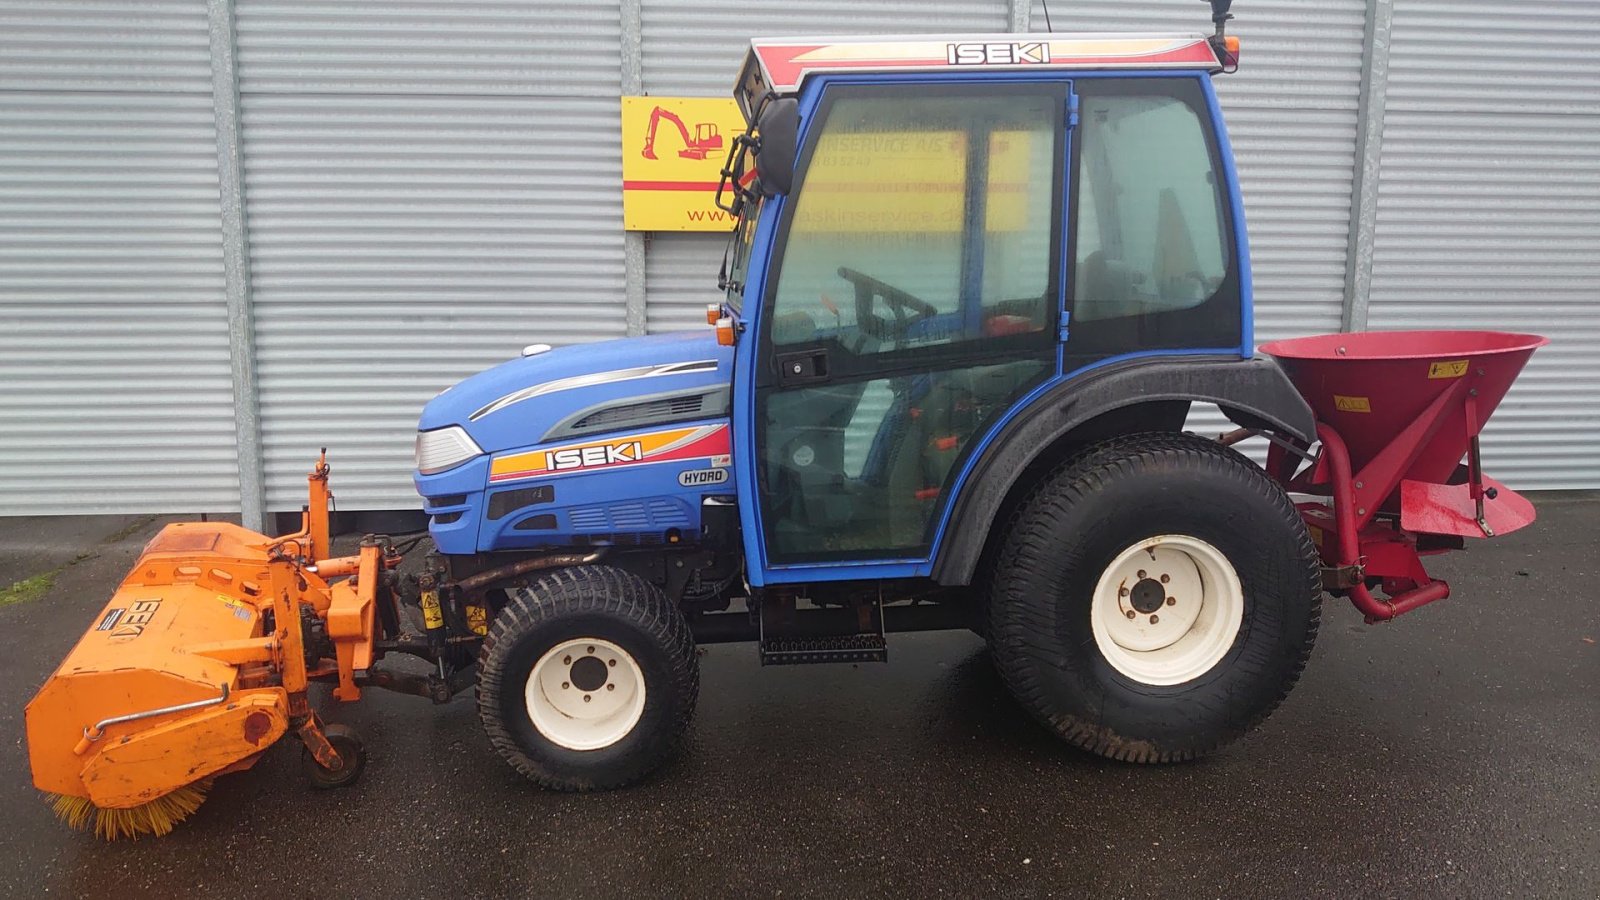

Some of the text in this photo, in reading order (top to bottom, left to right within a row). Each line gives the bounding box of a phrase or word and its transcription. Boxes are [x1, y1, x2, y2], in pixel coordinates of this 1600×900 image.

[946, 42, 1051, 65] ISEKI
[545, 441, 644, 471] ISEKI
[684, 470, 723, 484] HYDRO
[108, 597, 164, 641] ISEKI
